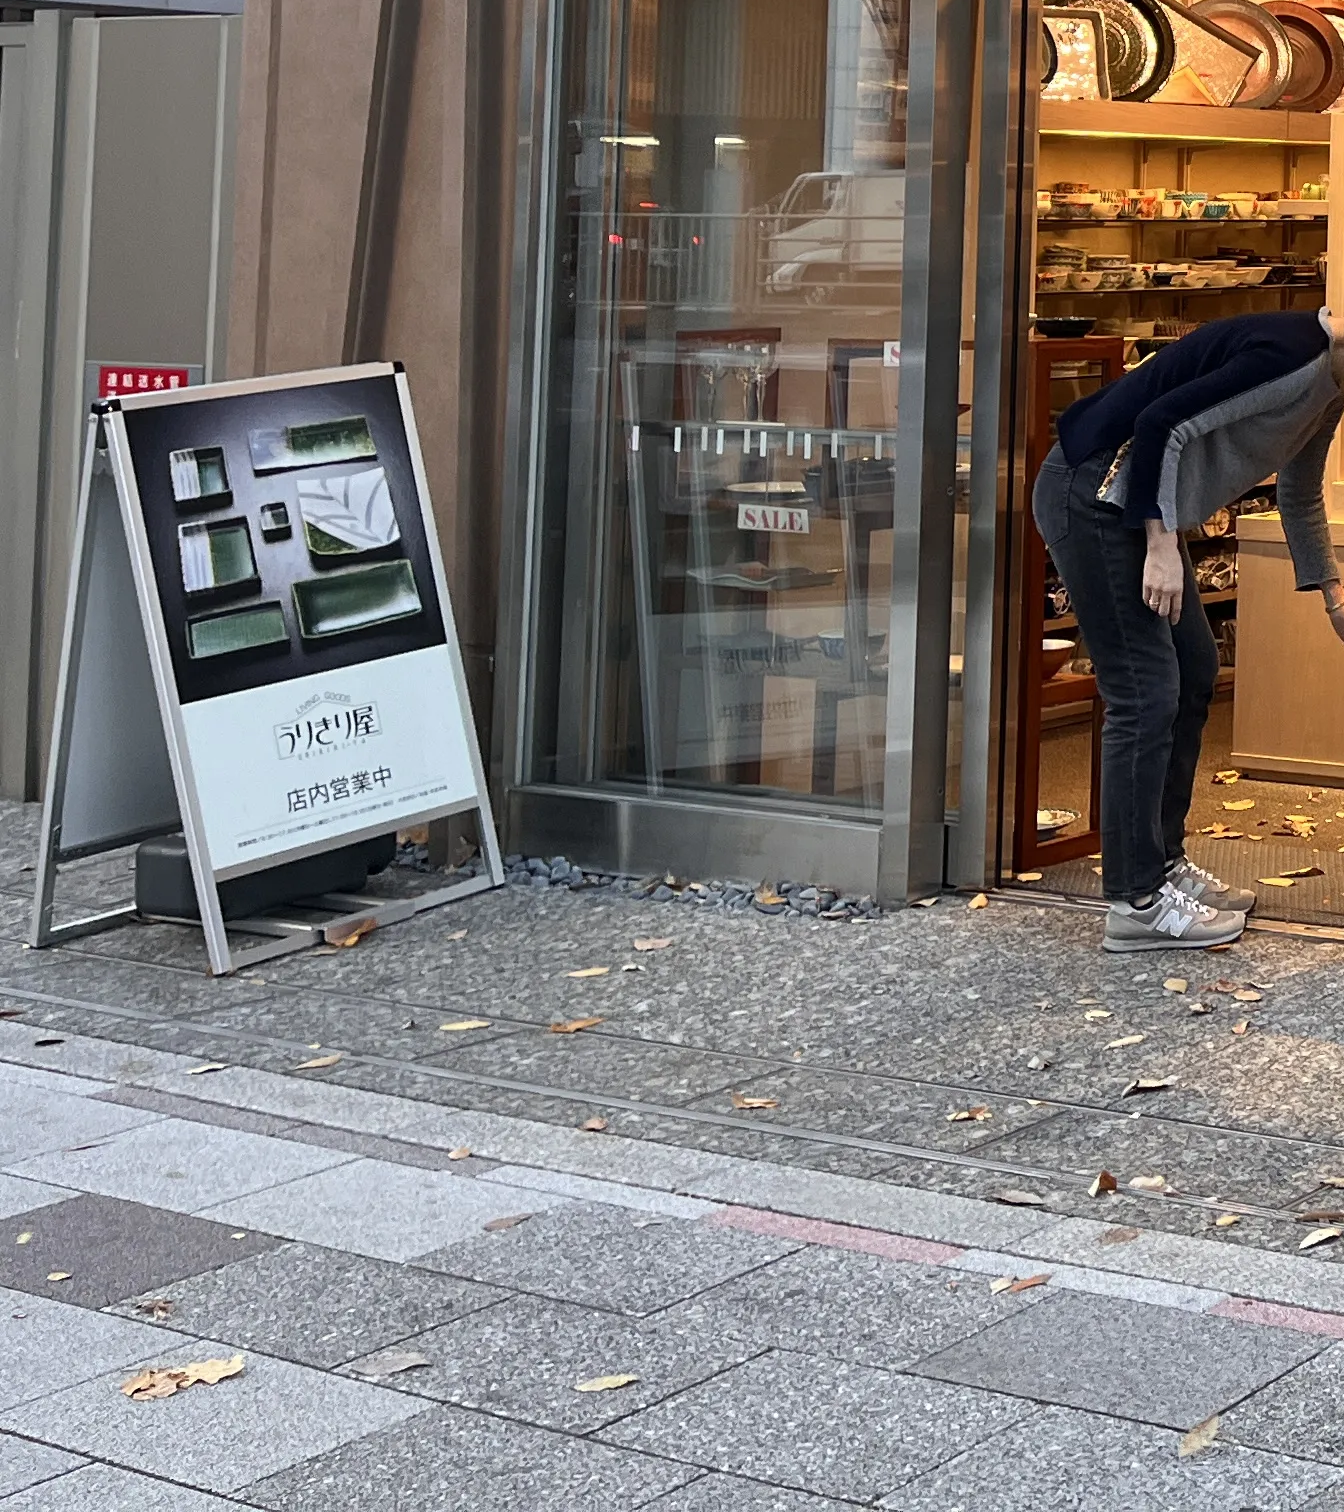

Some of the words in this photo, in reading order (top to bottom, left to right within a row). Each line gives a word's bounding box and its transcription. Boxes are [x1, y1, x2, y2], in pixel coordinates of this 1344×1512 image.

[743, 508, 803, 531] SALE
[279, 705, 380, 754] うりきり屋
[286, 765, 393, 814] 店内営業中
